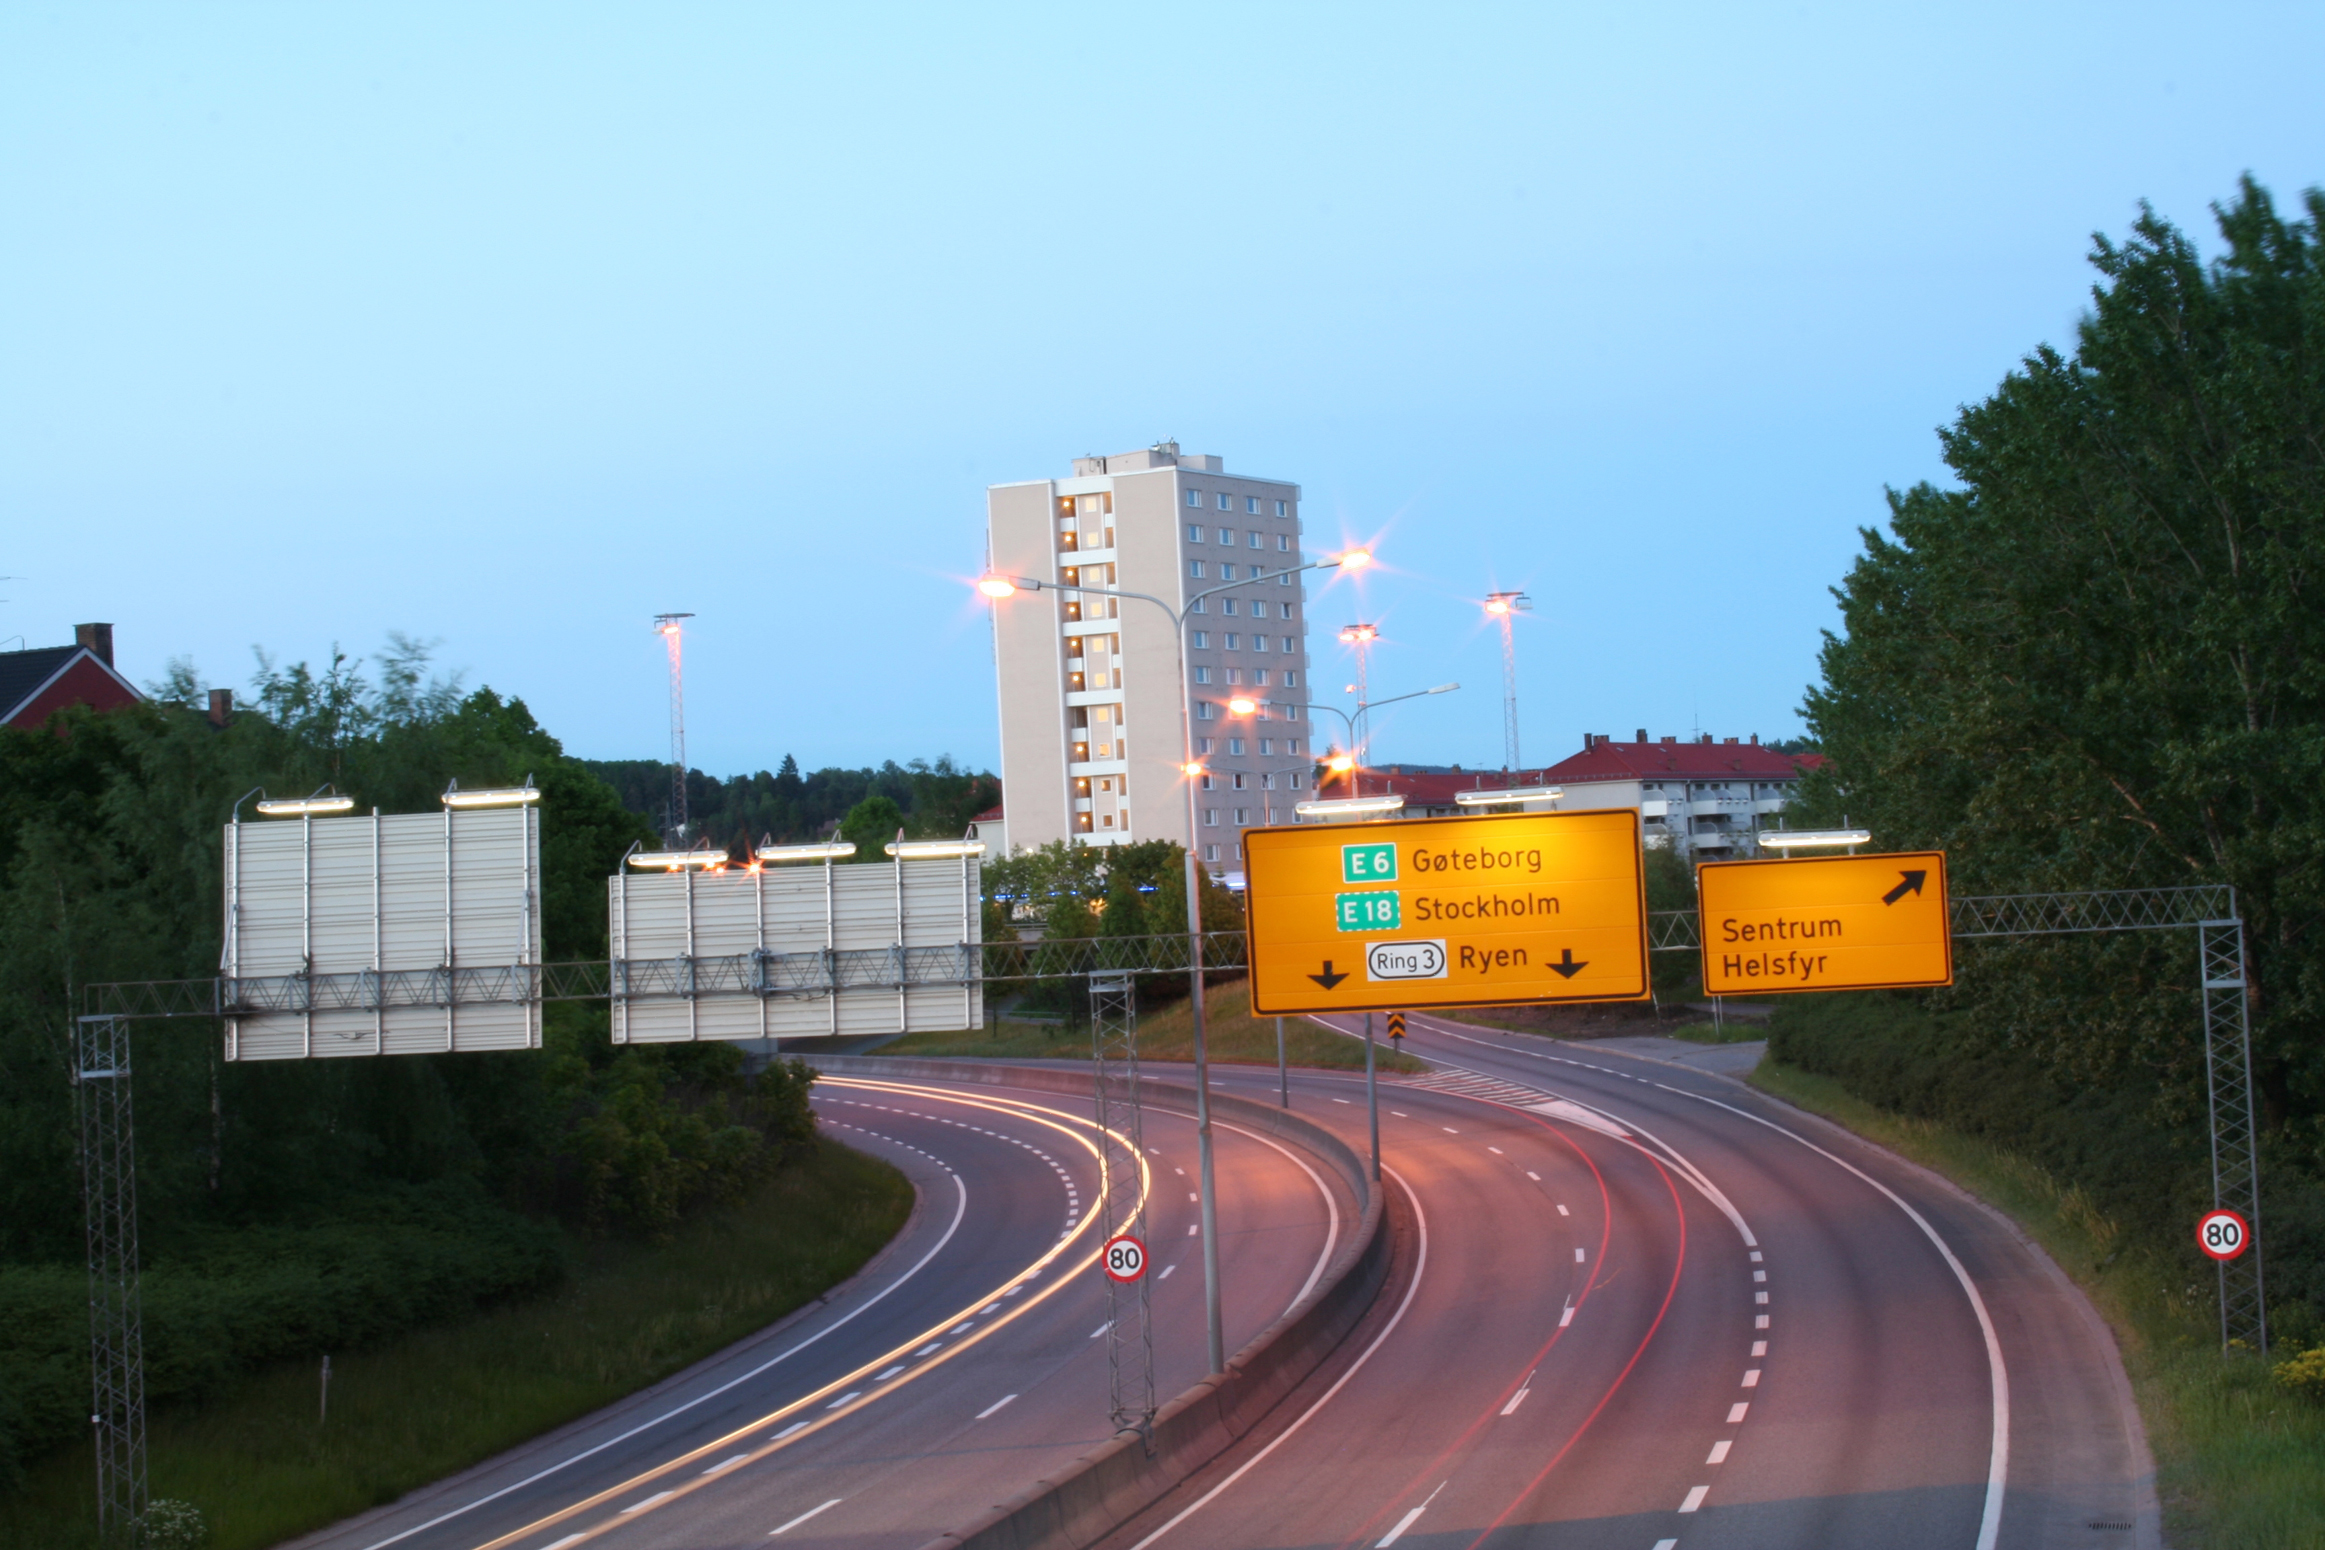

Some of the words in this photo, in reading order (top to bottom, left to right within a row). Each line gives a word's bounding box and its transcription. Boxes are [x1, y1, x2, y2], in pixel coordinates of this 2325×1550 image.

[1412, 846, 1542, 873] Gøteborg
[1415, 892, 1560, 921] Stockholm
[1722, 917, 1842, 942] Sentrum
[1376, 952, 1417, 973] Ring
[1422, 949, 1435, 970] 3
[1459, 945, 1528, 974] Ryen
[1723, 951, 1828, 981] Helsfyr
[2206, 1222, 2239, 1247] 80
[1110, 1247, 1140, 1270] 80
